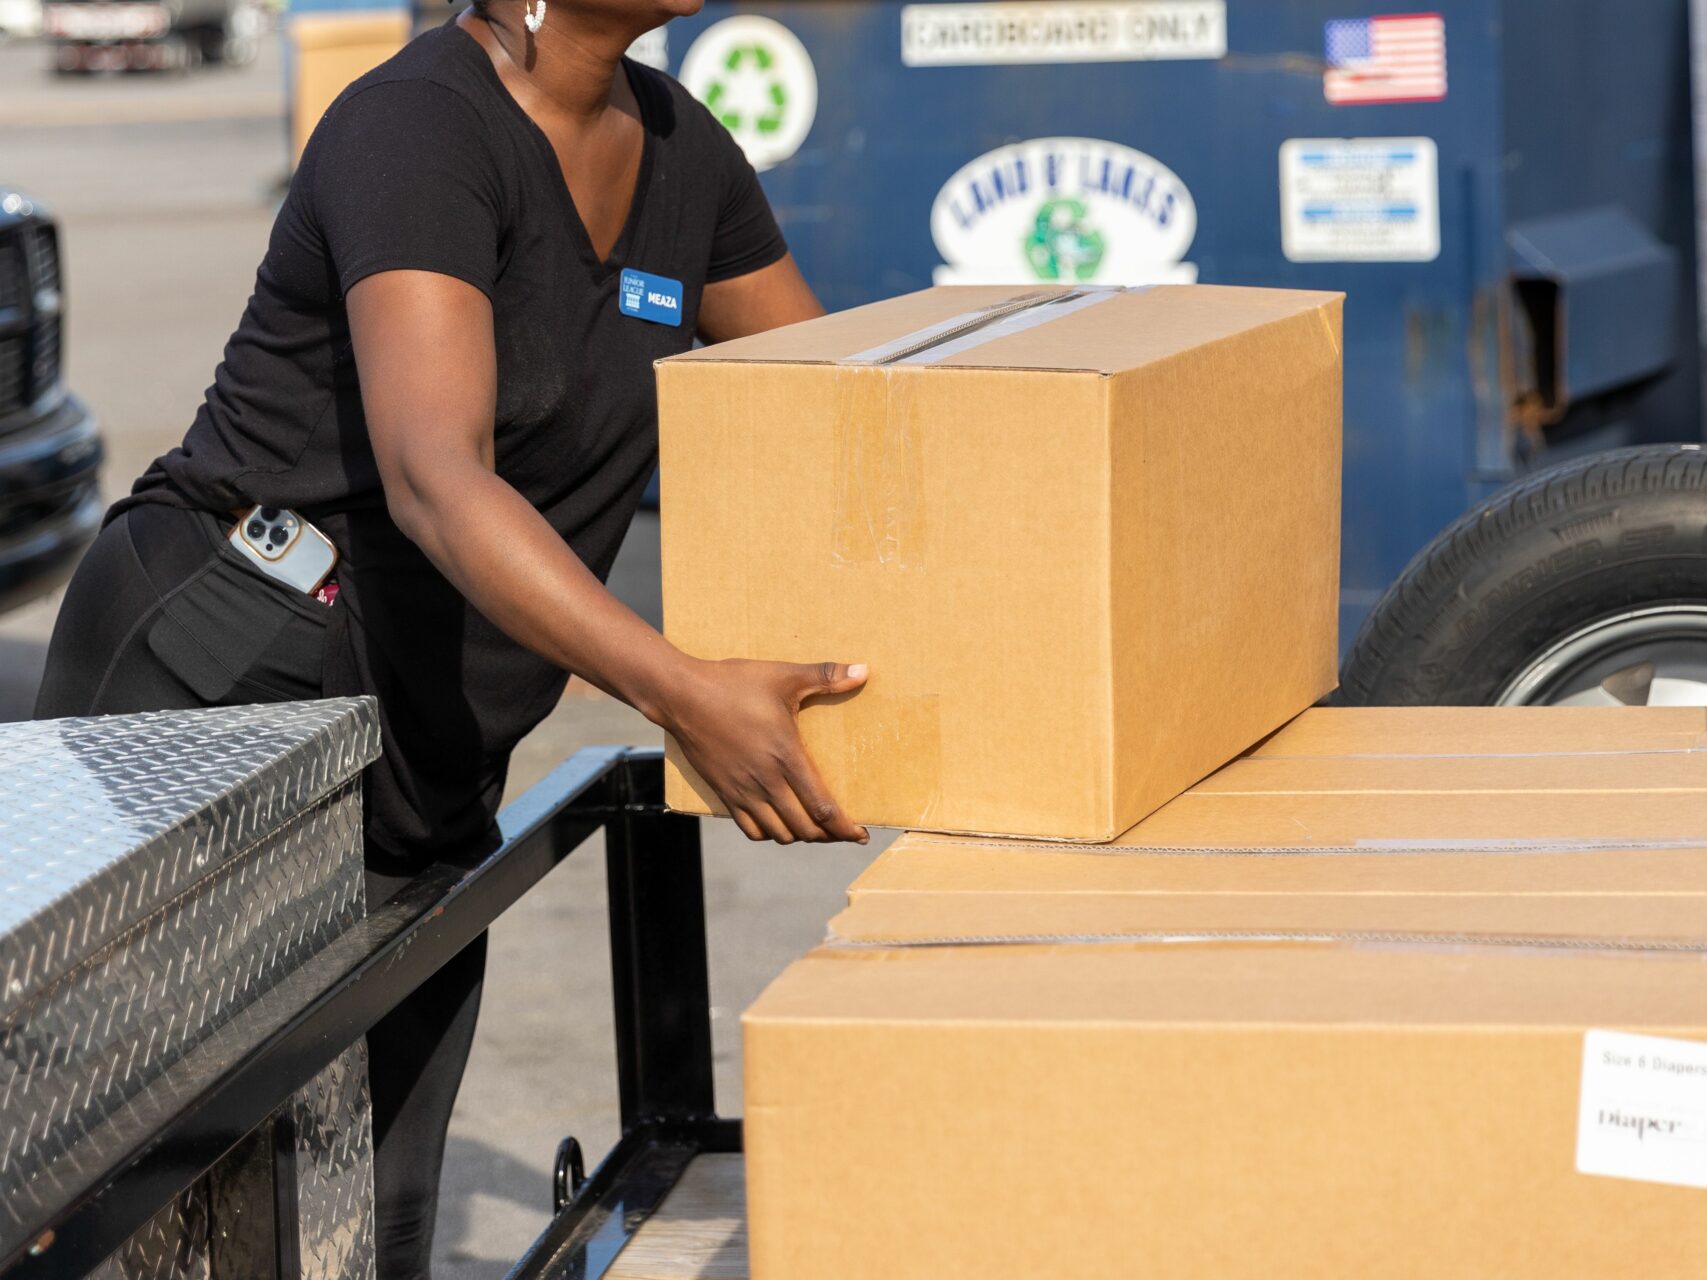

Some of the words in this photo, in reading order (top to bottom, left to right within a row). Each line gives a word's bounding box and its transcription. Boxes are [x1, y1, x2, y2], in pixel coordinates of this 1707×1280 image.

[910, 10, 1116, 48] CARDBOARD
[1124, 9, 1214, 44] ONLY
[948, 158, 1029, 228] LAND
[1076, 157, 1180, 226] LAKES
[647, 292, 677, 309] MEAZA
[1602, 1050, 1632, 1066] Size
[1638, 1055, 1647, 1069] 6
[1652, 1056, 1707, 1076] Diapers
[1598, 1108, 1683, 1144] Diaper
